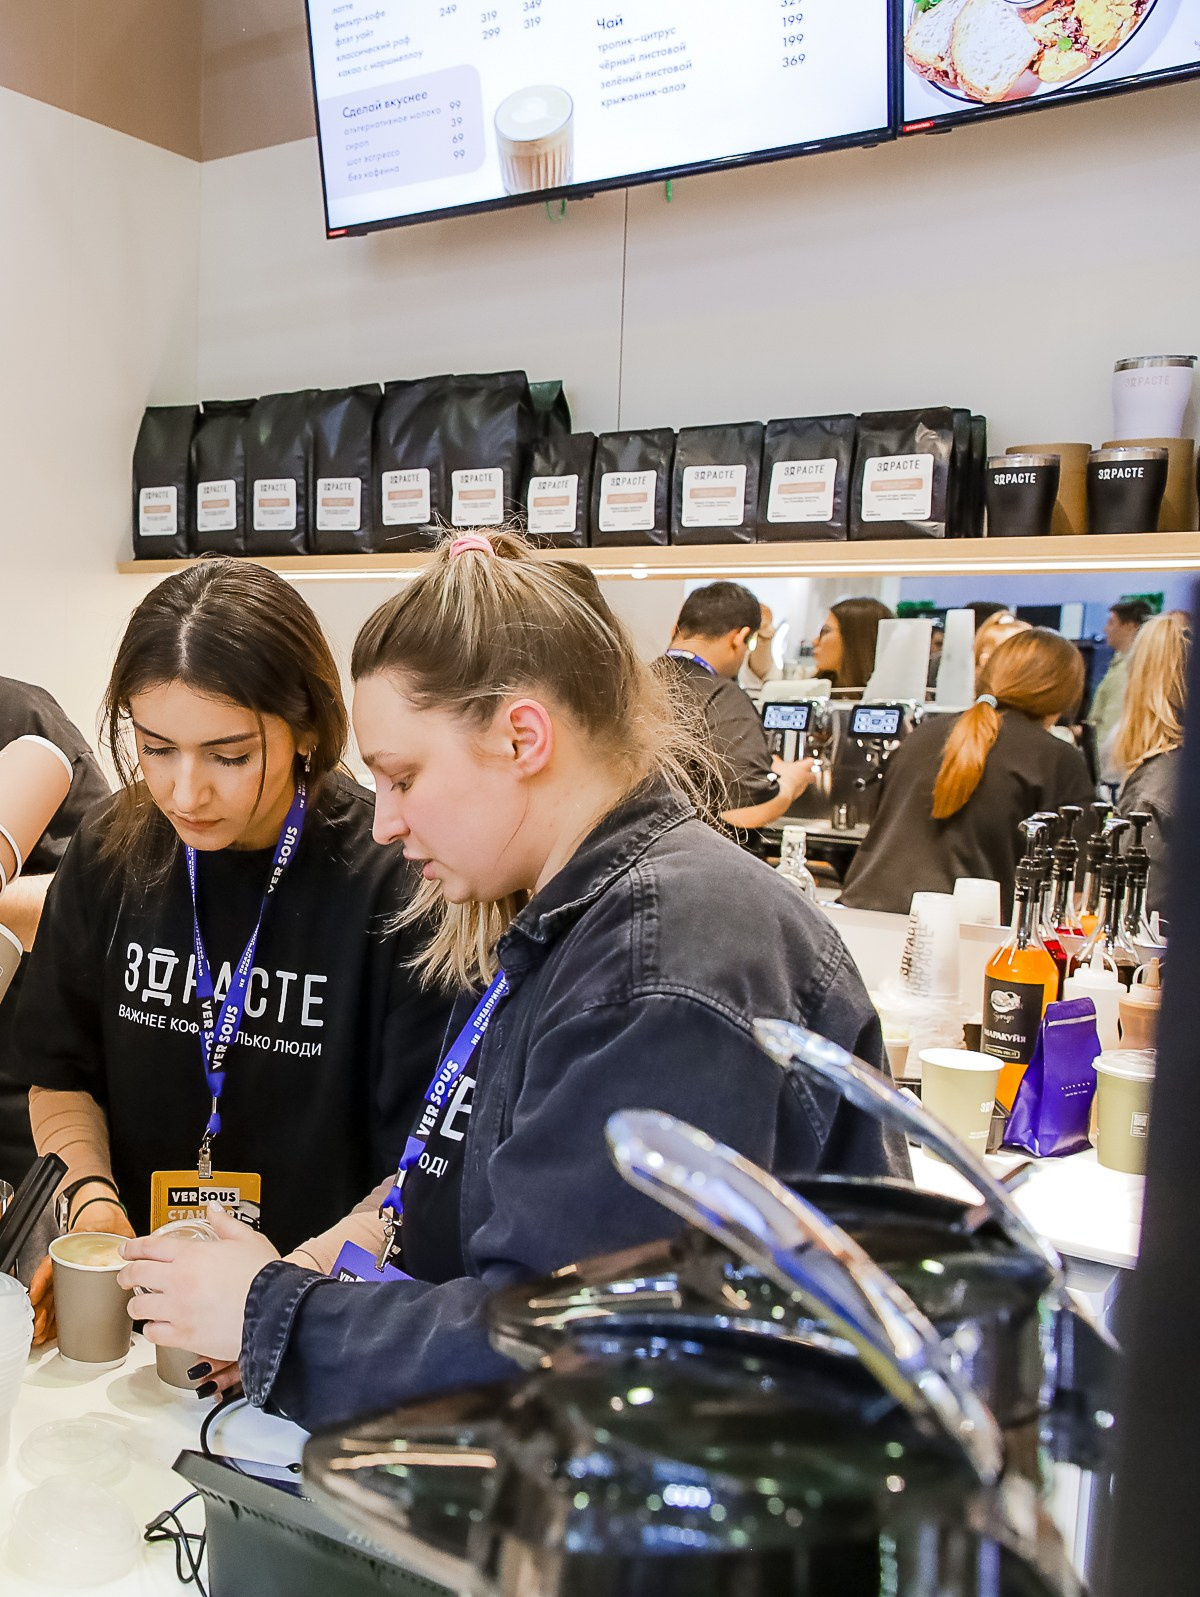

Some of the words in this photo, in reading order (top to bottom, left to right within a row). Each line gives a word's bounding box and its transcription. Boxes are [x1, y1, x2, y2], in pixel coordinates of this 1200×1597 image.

[440, 4, 457, 18] 249
[523, 0, 542, 12] 349
[481, 10, 498, 24] 319
[524, 16, 541, 30] 319
[596, 14, 623, 30] Чай
[782, 14, 804, 28] 199
[482, 27, 500, 40] 299
[784, 34, 804, 48] 199
[638, 42, 686, 62] листовой
[782, 54, 806, 68] 369
[644, 60, 692, 80] листовой
[342, 100, 382, 118] Сделай
[384, 92, 428, 110] вкуснее
[450, 100, 462, 112] 99
[450, 116, 463, 128] 39
[452, 133, 464, 144] 69
[454, 149, 466, 160] 99
[994, 472, 1036, 486] ЗДРАСТЕ
[1098, 466, 1144, 480] ЗДРАСТЕ
[118, 1004, 166, 1029] ВАЖНЕЕ
[170, 1017, 202, 1036] КОФ
[234, 1030, 270, 1050] ЛЬКО
[273, 1039, 322, 1058] ЛЮДИ
[168, 1210, 242, 1220] СТАНРТ
